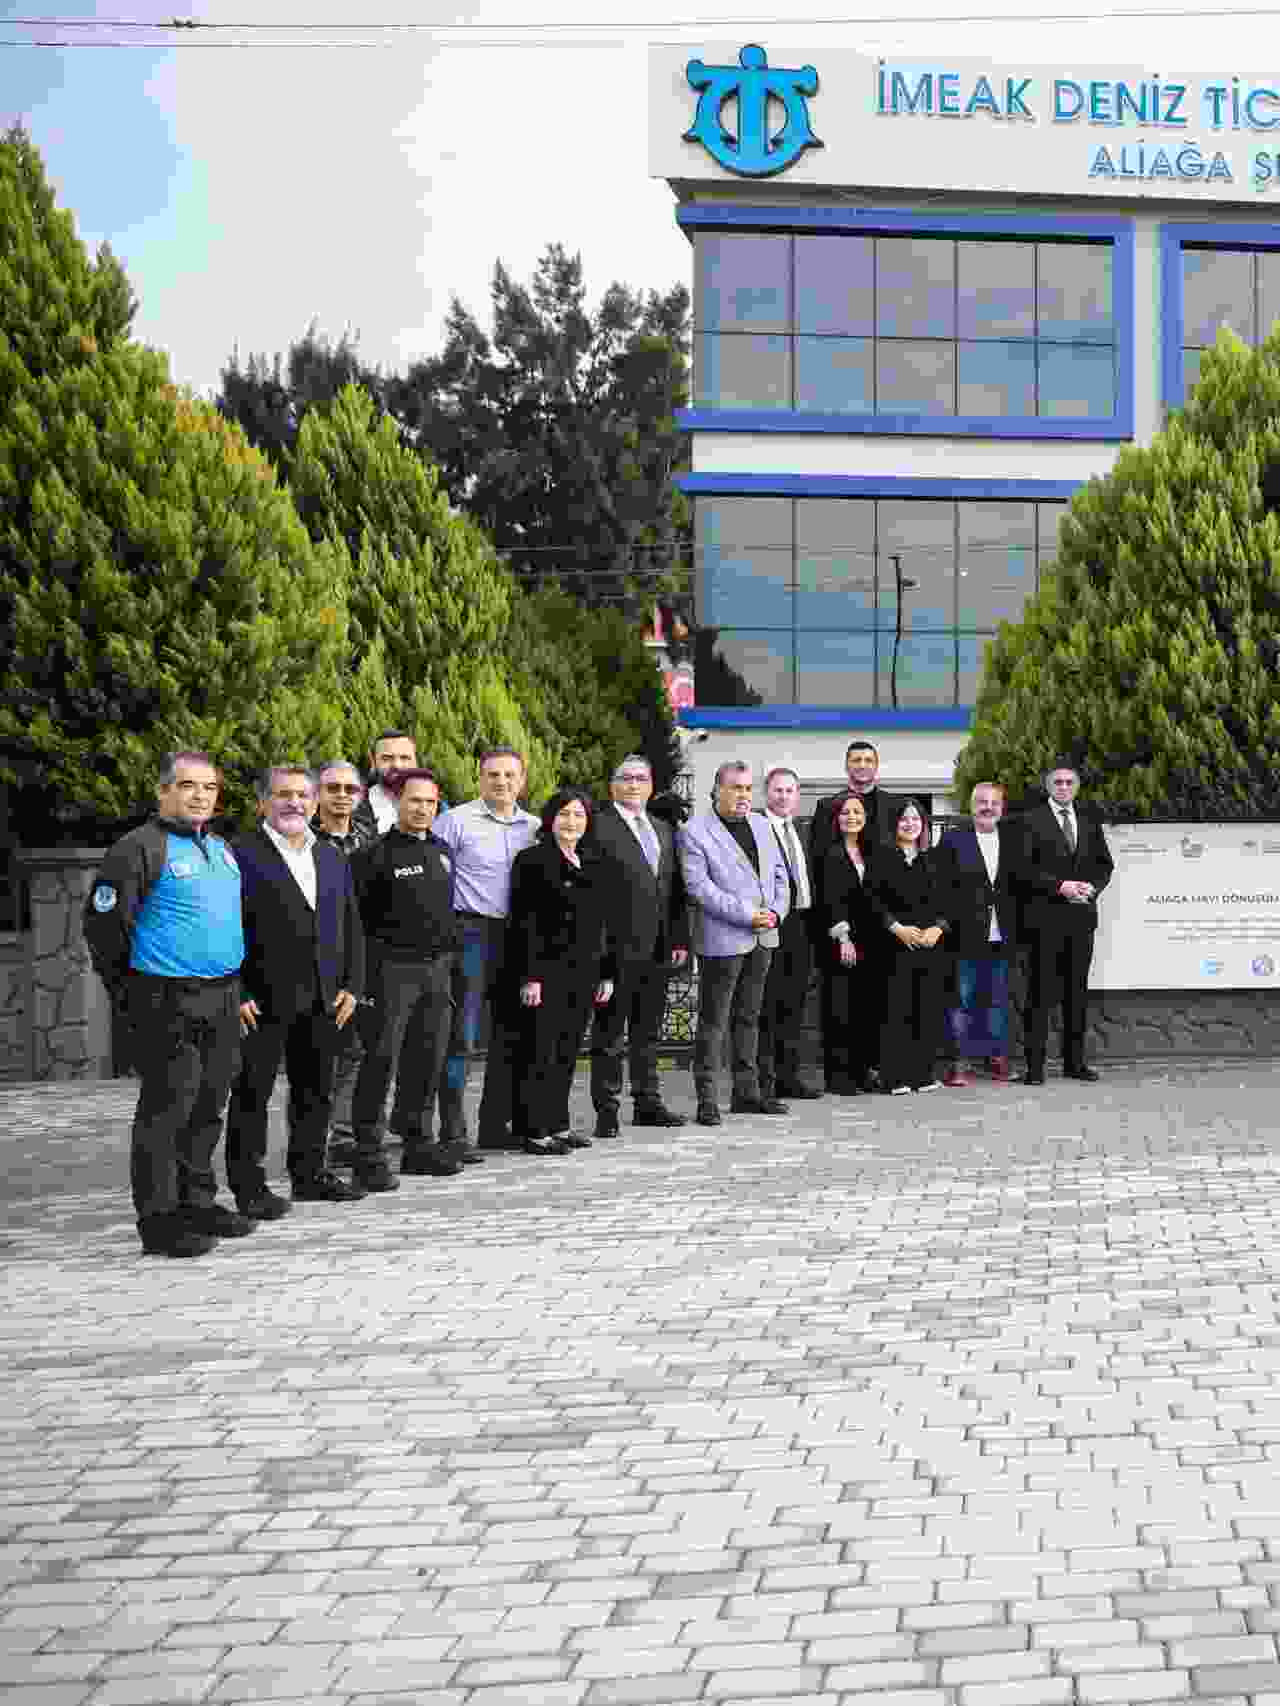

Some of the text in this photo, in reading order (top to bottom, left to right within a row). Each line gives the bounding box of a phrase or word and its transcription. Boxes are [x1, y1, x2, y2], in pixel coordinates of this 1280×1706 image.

[877, 58, 1033, 118] İMEAK
[1053, 73, 1189, 124] DENİZ
[1089, 137, 1233, 181] ALİAĞA
